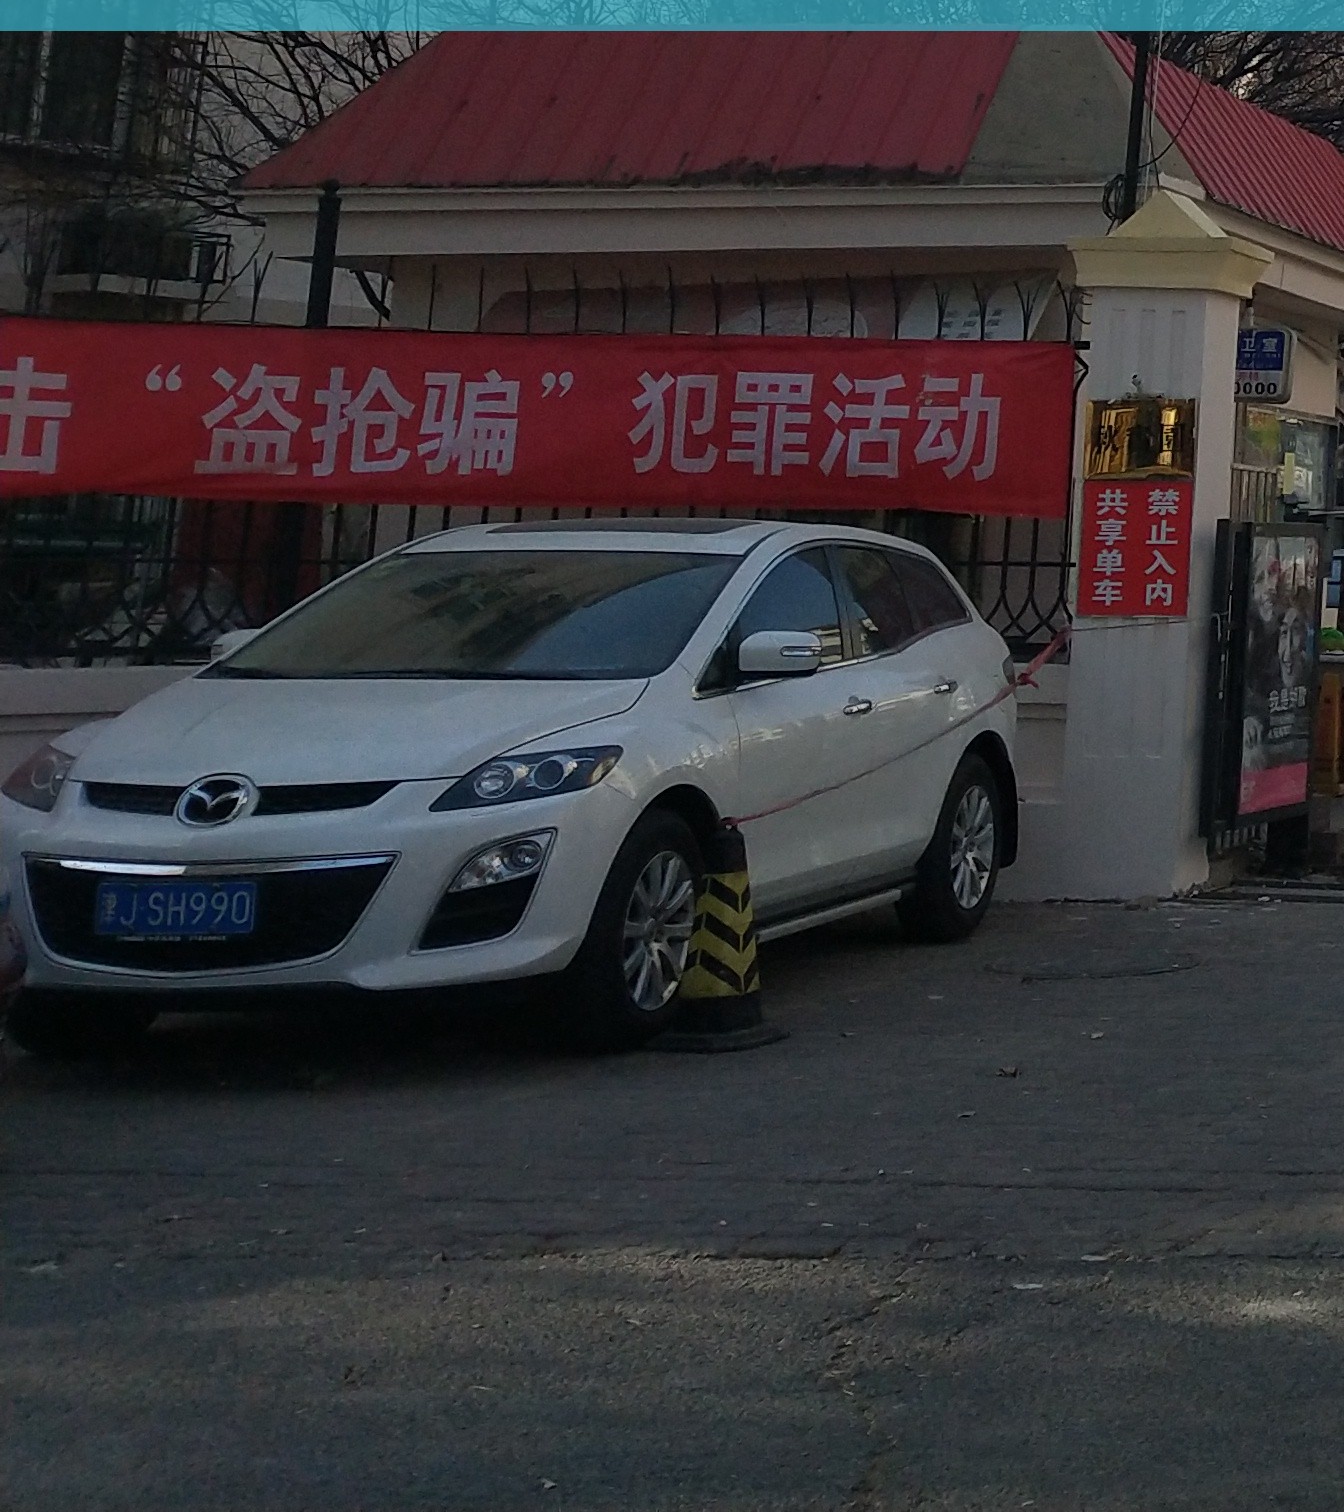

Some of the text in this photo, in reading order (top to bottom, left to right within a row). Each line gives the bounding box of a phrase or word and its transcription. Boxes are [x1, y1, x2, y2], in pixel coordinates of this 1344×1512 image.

[1092, 489, 1129, 607] 共享单车
[1144, 489, 1180, 607] 禁止入内
